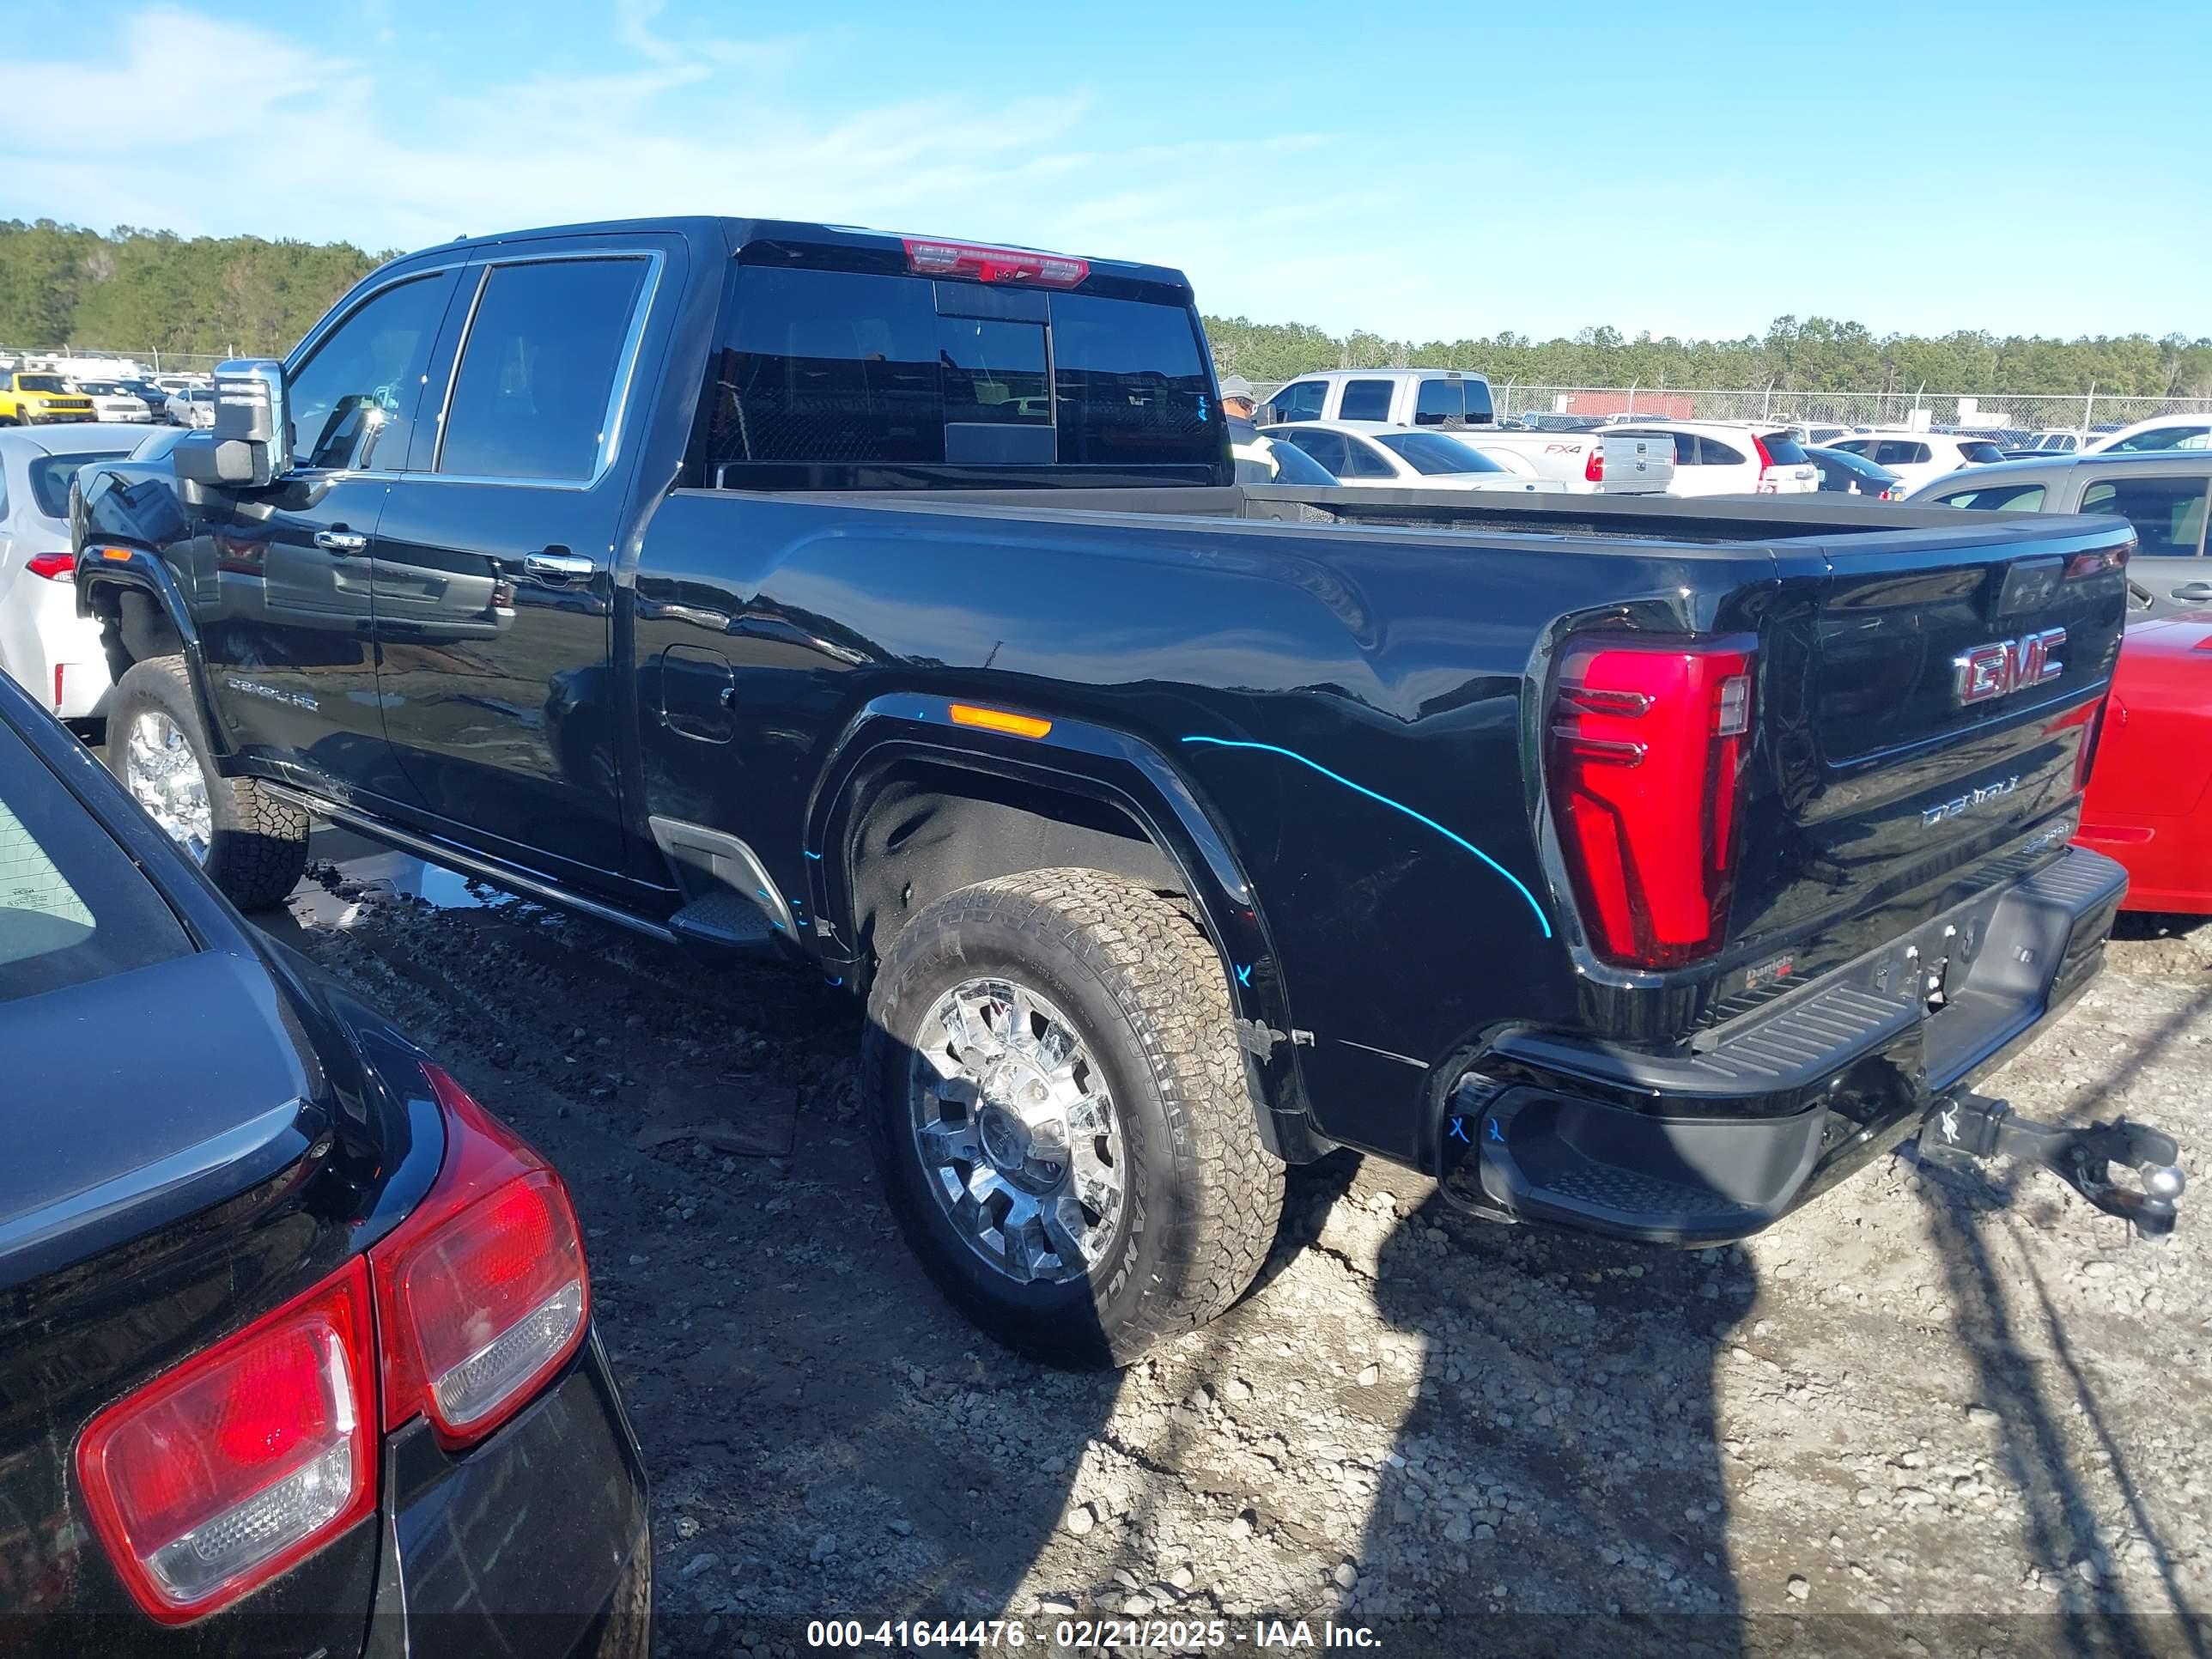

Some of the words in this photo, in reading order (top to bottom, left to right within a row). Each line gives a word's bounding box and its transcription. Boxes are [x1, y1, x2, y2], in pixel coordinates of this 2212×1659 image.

[1544, 444, 1583, 455] FX4
[1953, 626, 2069, 707] GMC
[1745, 953, 1795, 981] Daniels
